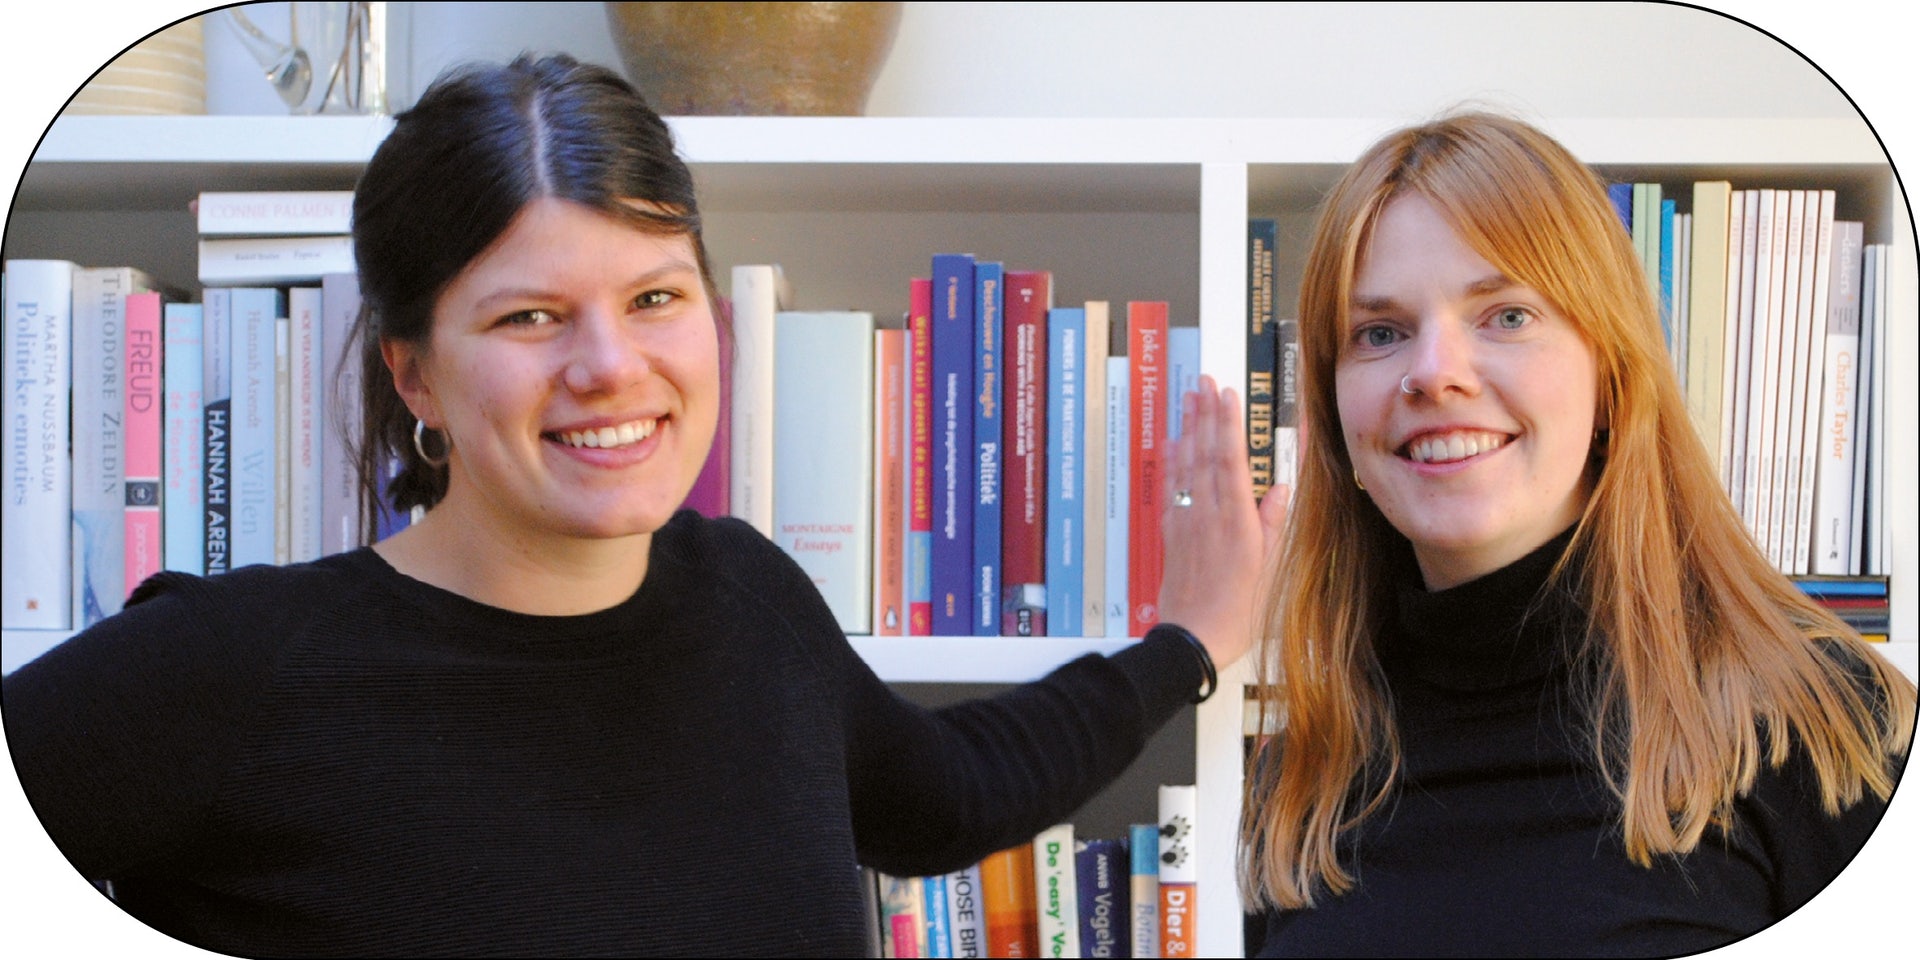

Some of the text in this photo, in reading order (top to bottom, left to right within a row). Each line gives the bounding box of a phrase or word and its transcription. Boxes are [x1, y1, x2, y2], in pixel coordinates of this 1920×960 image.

[1840, 236, 1858, 297] denkers
[131, 329, 152, 413] FREUD
[246, 309, 262, 430] Hannah Arendt
[983, 354, 994, 369] en
[1062, 371, 1076, 382] IN
[1139, 328, 1159, 363] Joke
[1283, 342, 1298, 404] Foucault
[1834, 350, 1852, 406] Charles
[13, 301, 38, 506] Politieke emoties
[41, 315, 57, 493] MARTHA NUSSBAUM
[101, 274, 120, 496] THEODORE ZELDIN
[913, 316, 927, 519] Welke taal spreekt de muziek?
[1062, 383, 1076, 396] DE
[1141, 376, 1159, 450] Hermsen
[208, 410, 226, 504] HANNAH
[1250, 371, 1272, 500] IK HEB EEN
[1829, 410, 1850, 462] Taylor
[240, 449, 266, 536] Willen
[979, 442, 997, 504] Politiek
[1062, 455, 1076, 500] FILOSOFIE
[782, 523, 854, 534] MONTAIGNE
[793, 537, 842, 554] Essays
[1045, 841, 1067, 957] De 'easy' Vo
[1090, 853, 1116, 957] ANWB Vogelg
[1166, 890, 1188, 955] Dier &
